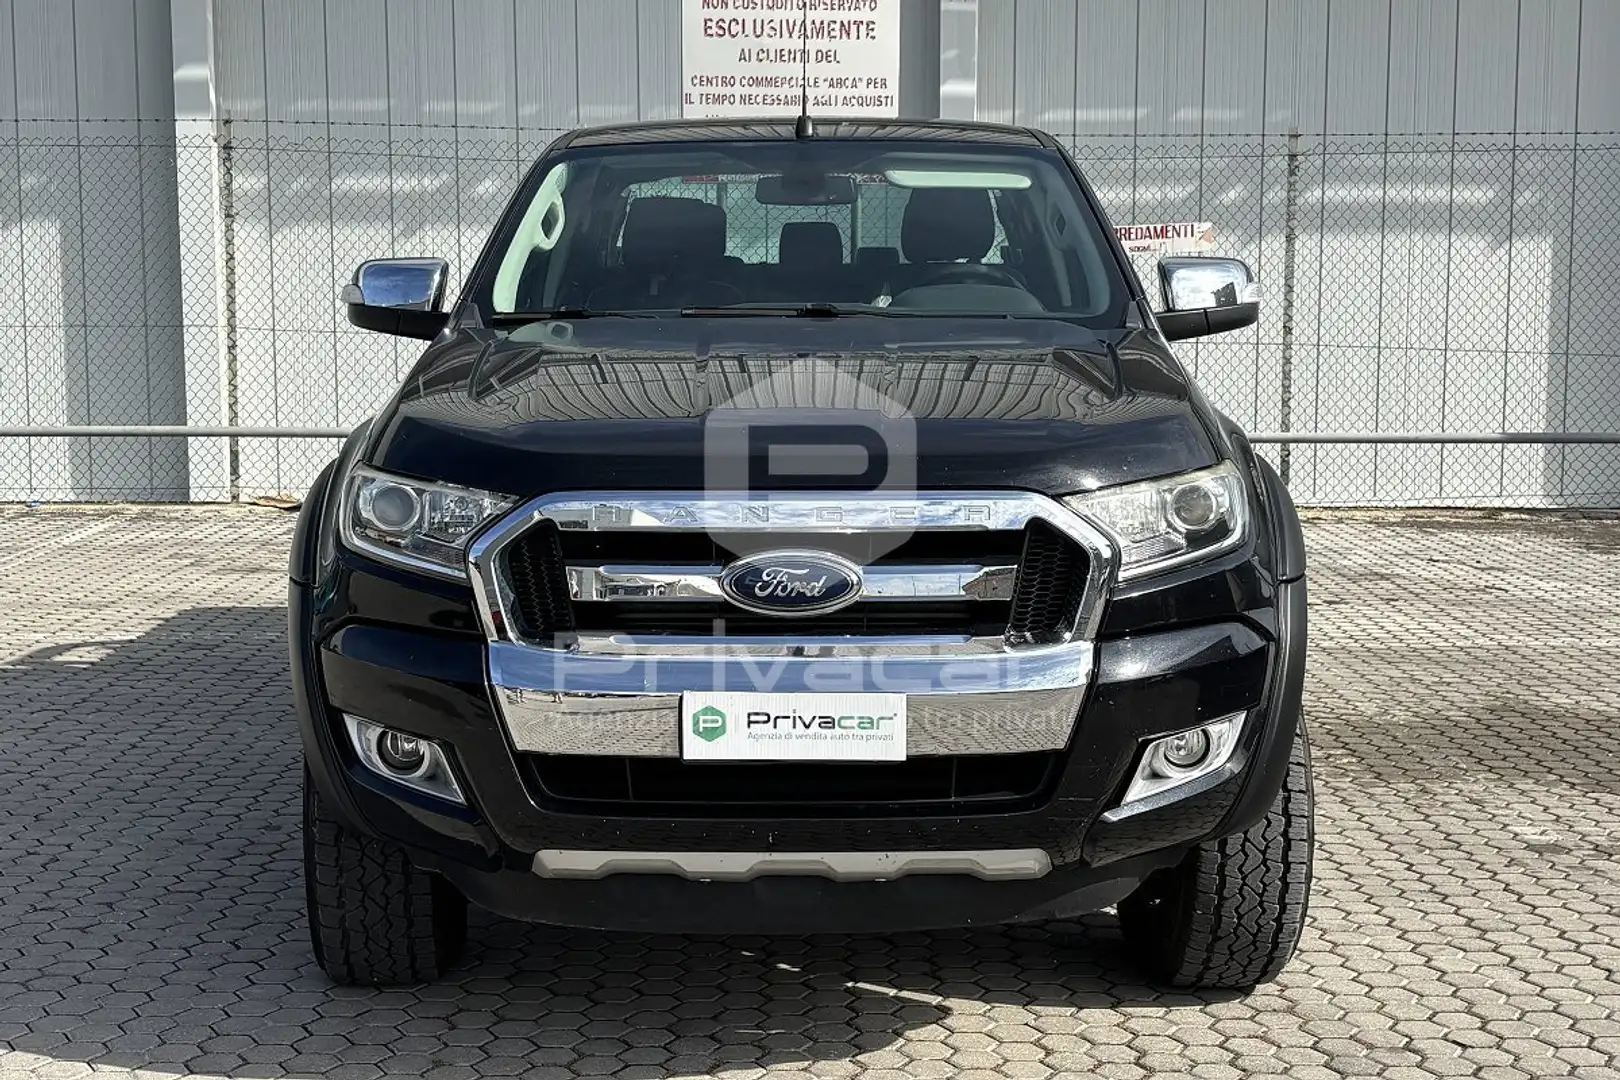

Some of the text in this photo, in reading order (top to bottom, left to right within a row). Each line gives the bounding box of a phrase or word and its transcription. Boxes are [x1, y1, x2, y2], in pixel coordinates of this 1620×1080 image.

[701, 0, 728, 10] NON
[703, 17, 876, 41] ESCLUSIVAMENTE
[738, 48, 841, 64] AI CLIENTI DEL
[691, 75, 736, 88] CENTRO
[866, 78, 888, 89] PER
[684, 93, 695, 105] IL
[699, 93, 736, 105] TEMPO
[812, 95, 838, 107] AGLI
[841, 95, 894, 107] ACQUISTI
[592, 505, 991, 523] RANGER
[754, 566, 826, 599] Ford
[747, 709, 893, 730] Privacar
[747, 732, 894, 743] Agenzia di vendita auto tra privati
